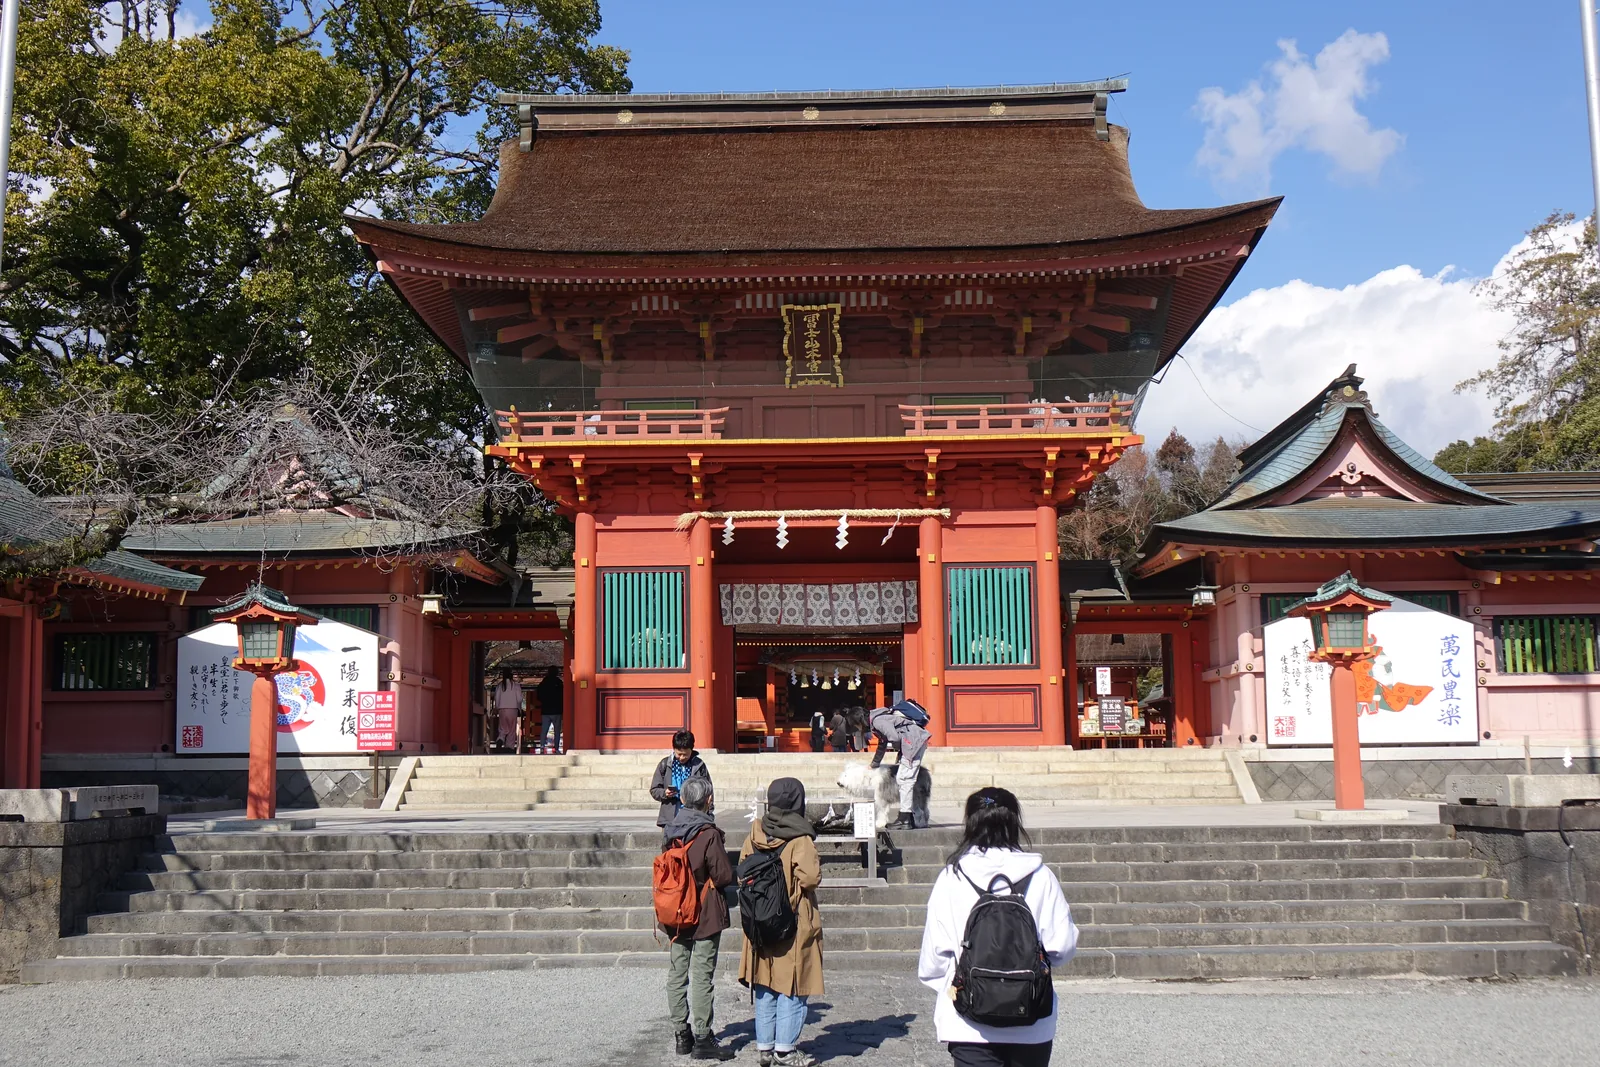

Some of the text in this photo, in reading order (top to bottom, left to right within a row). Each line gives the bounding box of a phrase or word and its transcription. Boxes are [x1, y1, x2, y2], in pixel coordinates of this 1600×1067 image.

[220, 655, 230, 725] 皇室に君と歩みし
[340, 645, 362, 737] 一陽来復
[1437, 633, 1462, 726] 萬民豊楽
